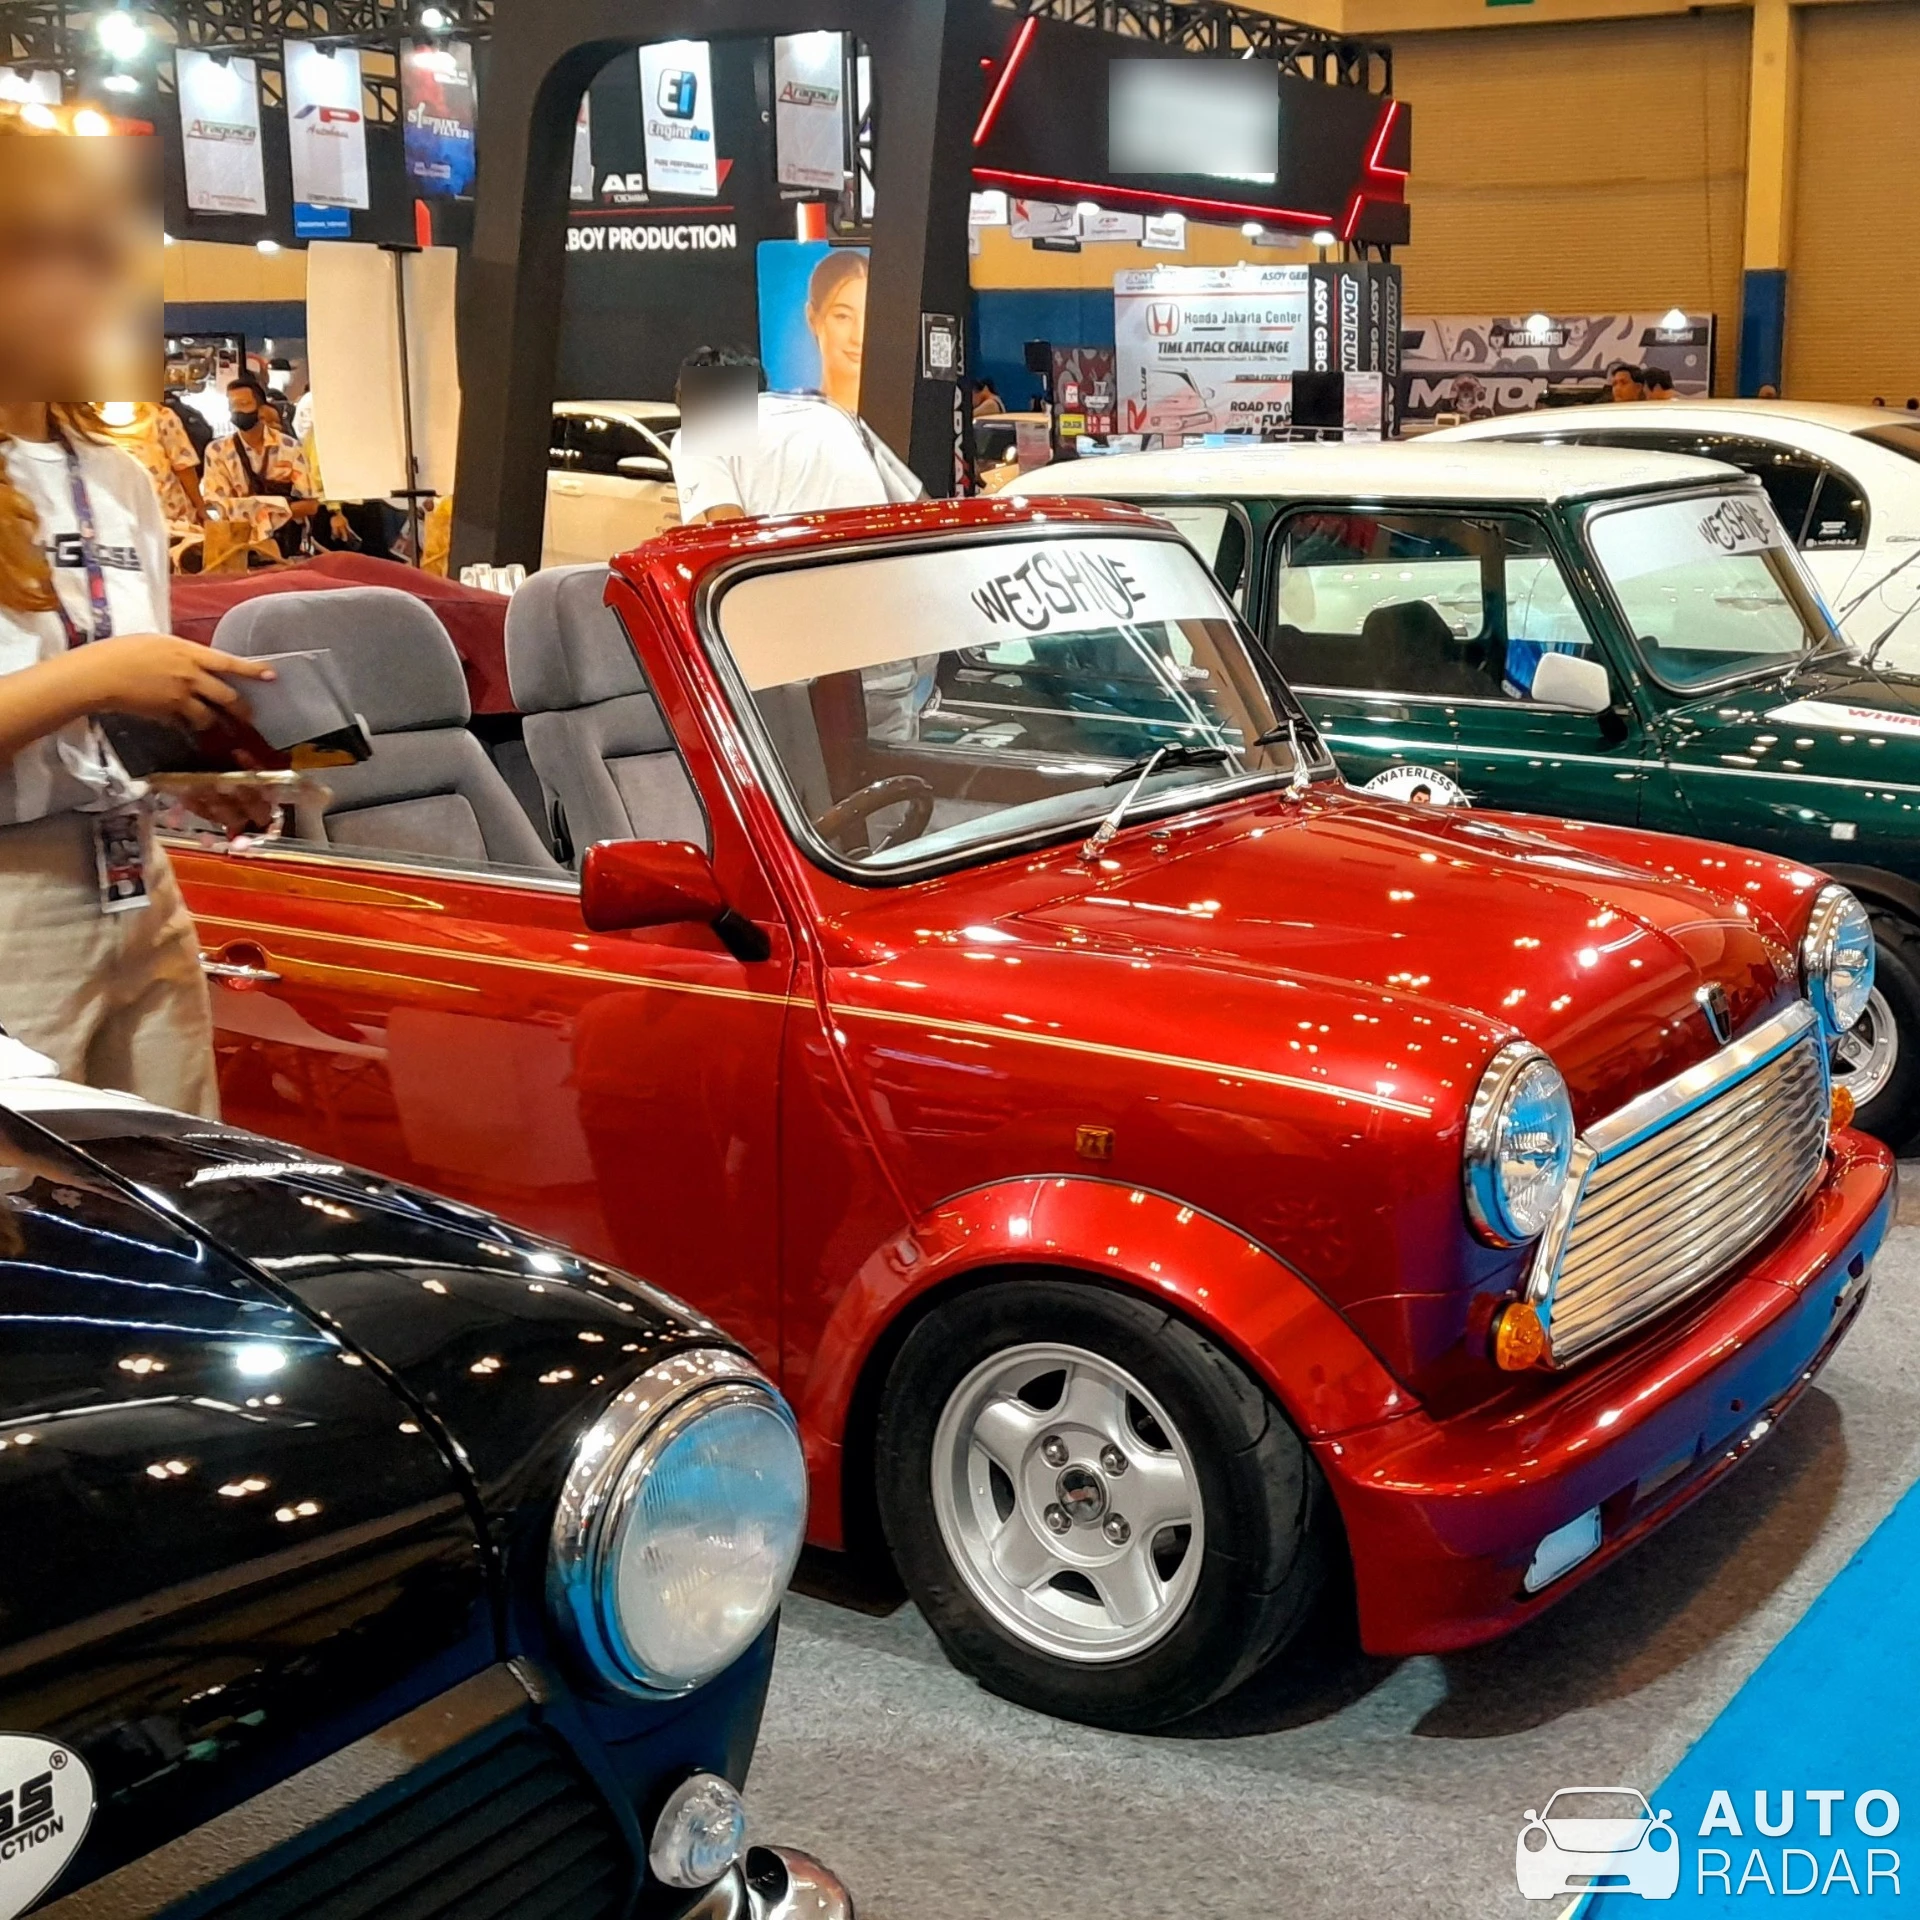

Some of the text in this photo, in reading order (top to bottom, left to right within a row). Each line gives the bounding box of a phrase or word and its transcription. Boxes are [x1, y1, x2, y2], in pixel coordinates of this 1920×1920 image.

[566, 224, 737, 250] BOY PRODUCTION
[1261, 273, 1286, 281] ASOY
[1314, 278, 1328, 325] ASOY
[1371, 279, 1379, 325] ASOY
[1184, 311, 1302, 324] Honda Jakarta Center
[1158, 341, 1289, 354] TIME ATTACK CHALLENGE
[1230, 401, 1264, 411] ROAD
[1266, 401, 1282, 411] TO
[971, 549, 1147, 632] WETSHINE
[1377, 767, 1452, 792] WATERLESS
